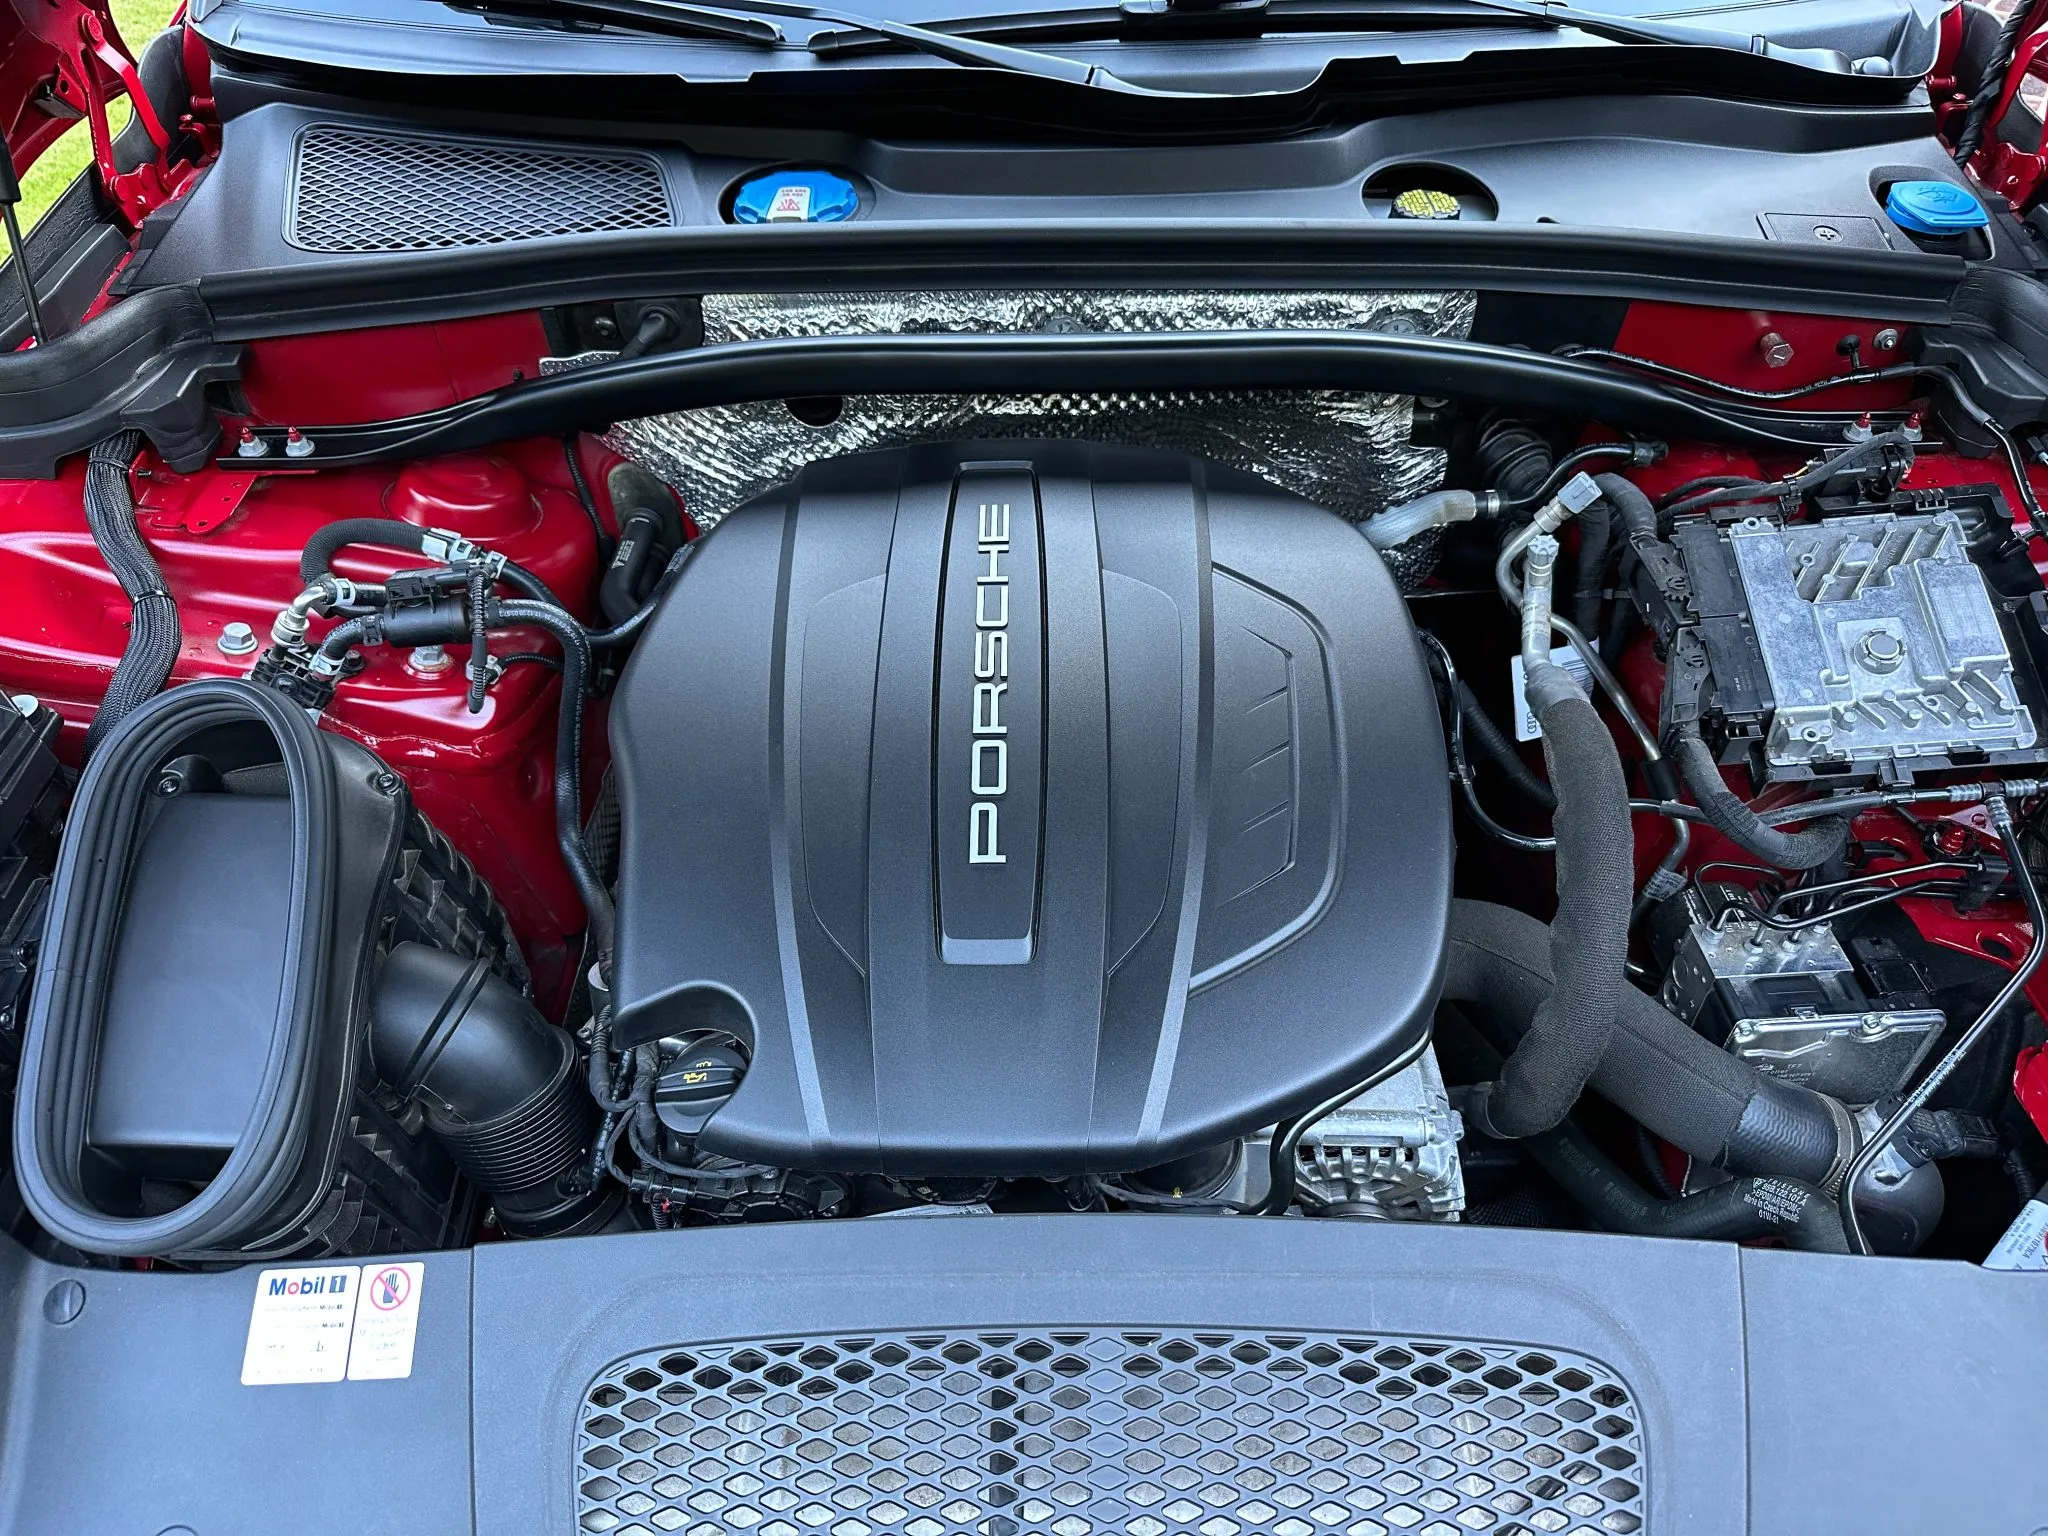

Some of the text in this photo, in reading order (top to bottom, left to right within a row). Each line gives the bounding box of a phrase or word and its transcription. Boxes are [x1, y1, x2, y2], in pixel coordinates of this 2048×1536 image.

[969, 503, 1009, 864] PORSCHE
[1762, 1183, 1807, 1206] 95B.122.101.A
[1768, 1179, 1811, 1199] TRISTONE
[1743, 1193, 1758, 1205] Made
[1763, 1200, 1779, 1215] Czech
[1779, 1207, 1800, 1223] Republic
[268, 1275, 347, 1296] Mobil 1
